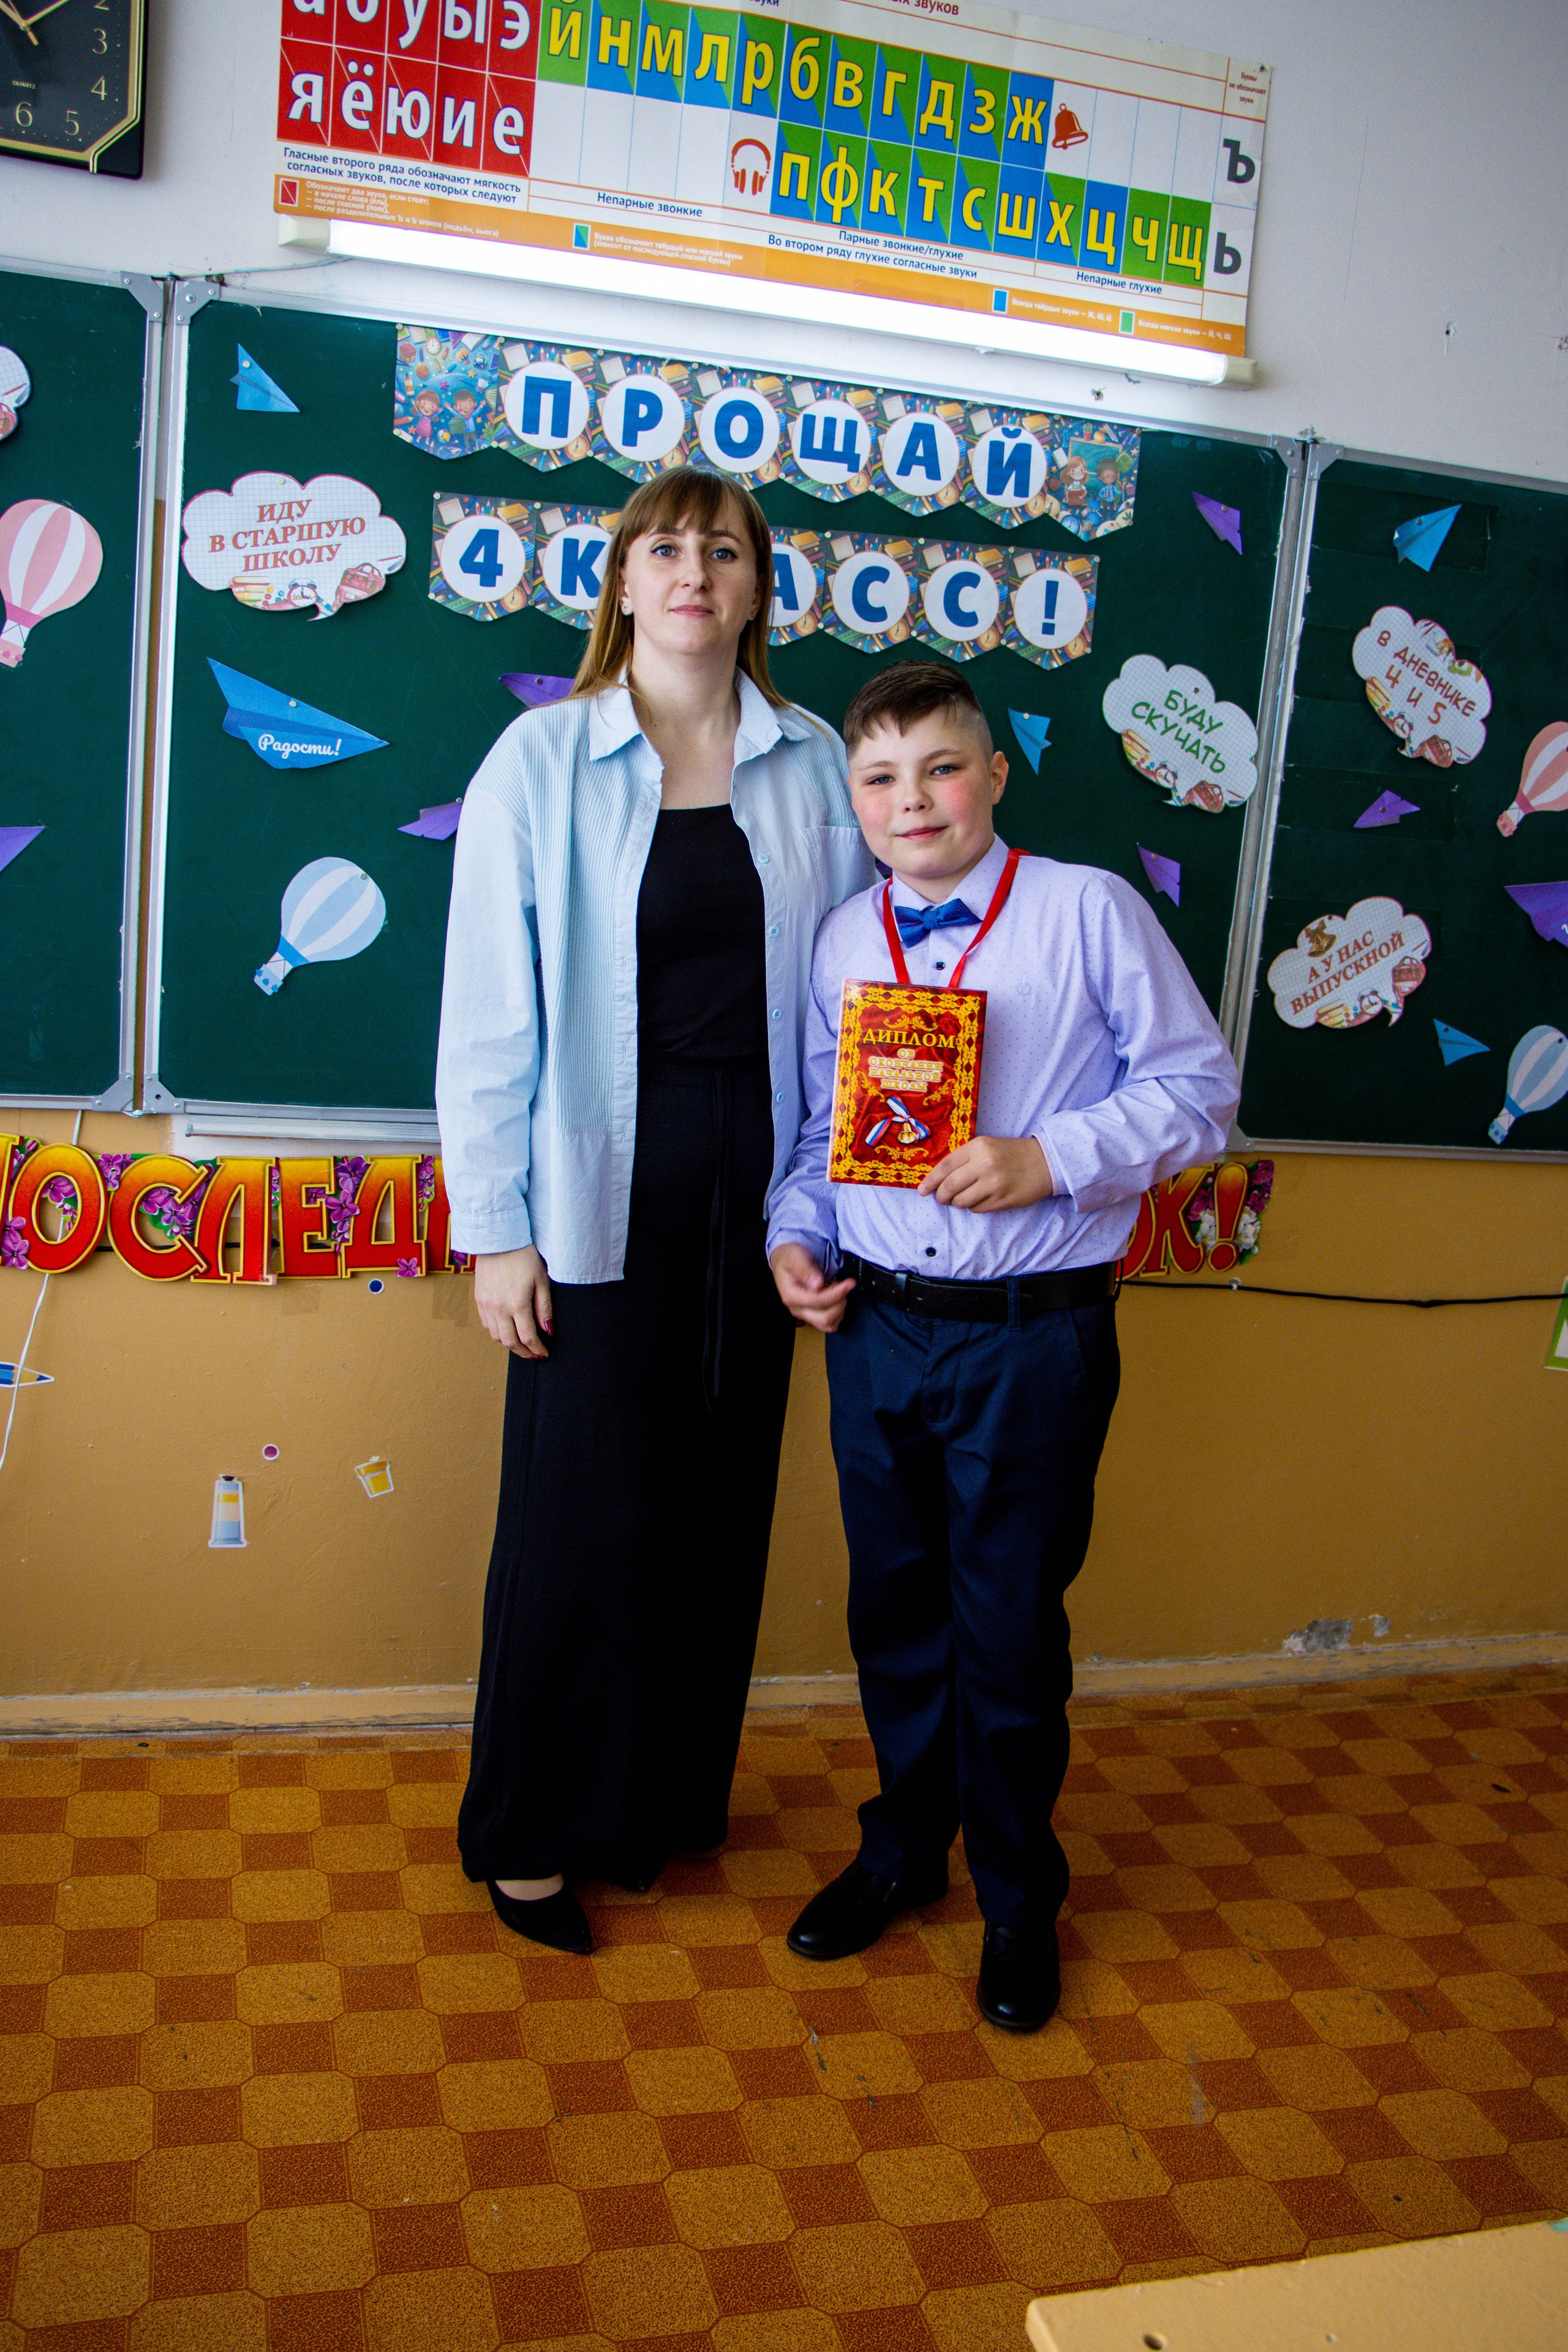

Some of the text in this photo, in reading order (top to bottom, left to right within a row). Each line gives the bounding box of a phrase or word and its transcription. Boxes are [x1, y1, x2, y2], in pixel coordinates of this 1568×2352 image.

[914, 0, 959, 15] звуков
[92, 28, 108, 54] 3
[91, 76, 107, 100] 4
[16, 102, 32, 127] 6
[65, 110, 80, 135] 5
[284, 147, 521, 192] Гласные второго ряда обозначают мягкость
[287, 162, 516, 203] согласных звуков, после которых следуют
[597, 192, 703, 217] Непарные звонкие
[768, 235, 977, 279] Во втором ряду глухие согласные звуки
[839, 230, 963, 262] Парные звонкие/глухие
[1076, 271, 1162, 296] Непарные глухие
[257, 499, 312, 524] ИДУ
[209, 517, 366, 552] В СТАРШУЮ
[242, 543, 342, 573] ШКОЛУ
[459, 529, 503, 587] 4
[1385, 665, 1403, 689] 4
[1428, 702, 1447, 725] 5
[1393, 647, 1476, 717] ДНЕВНИКЕ
[1164, 690, 1223, 734] БУДУ
[258, 734, 342, 759] Радости!
[1131, 702, 1226, 774] СКУЧАТЬ
[1308, 930, 1374, 984] А У НАС
[1290, 930, 1405, 1015] ВЫПУСКНОЙ
[862, 1028, 956, 1049] ДИПЛОМ
[869, 1057, 943, 1071] ОКОНЧАНИИ
[898, 1049, 914, 1058] ОБ
[870, 1068, 941, 1082] НАЧАЛЬНОЙ
[881, 1079, 927, 1091] ШКОЛЫ
